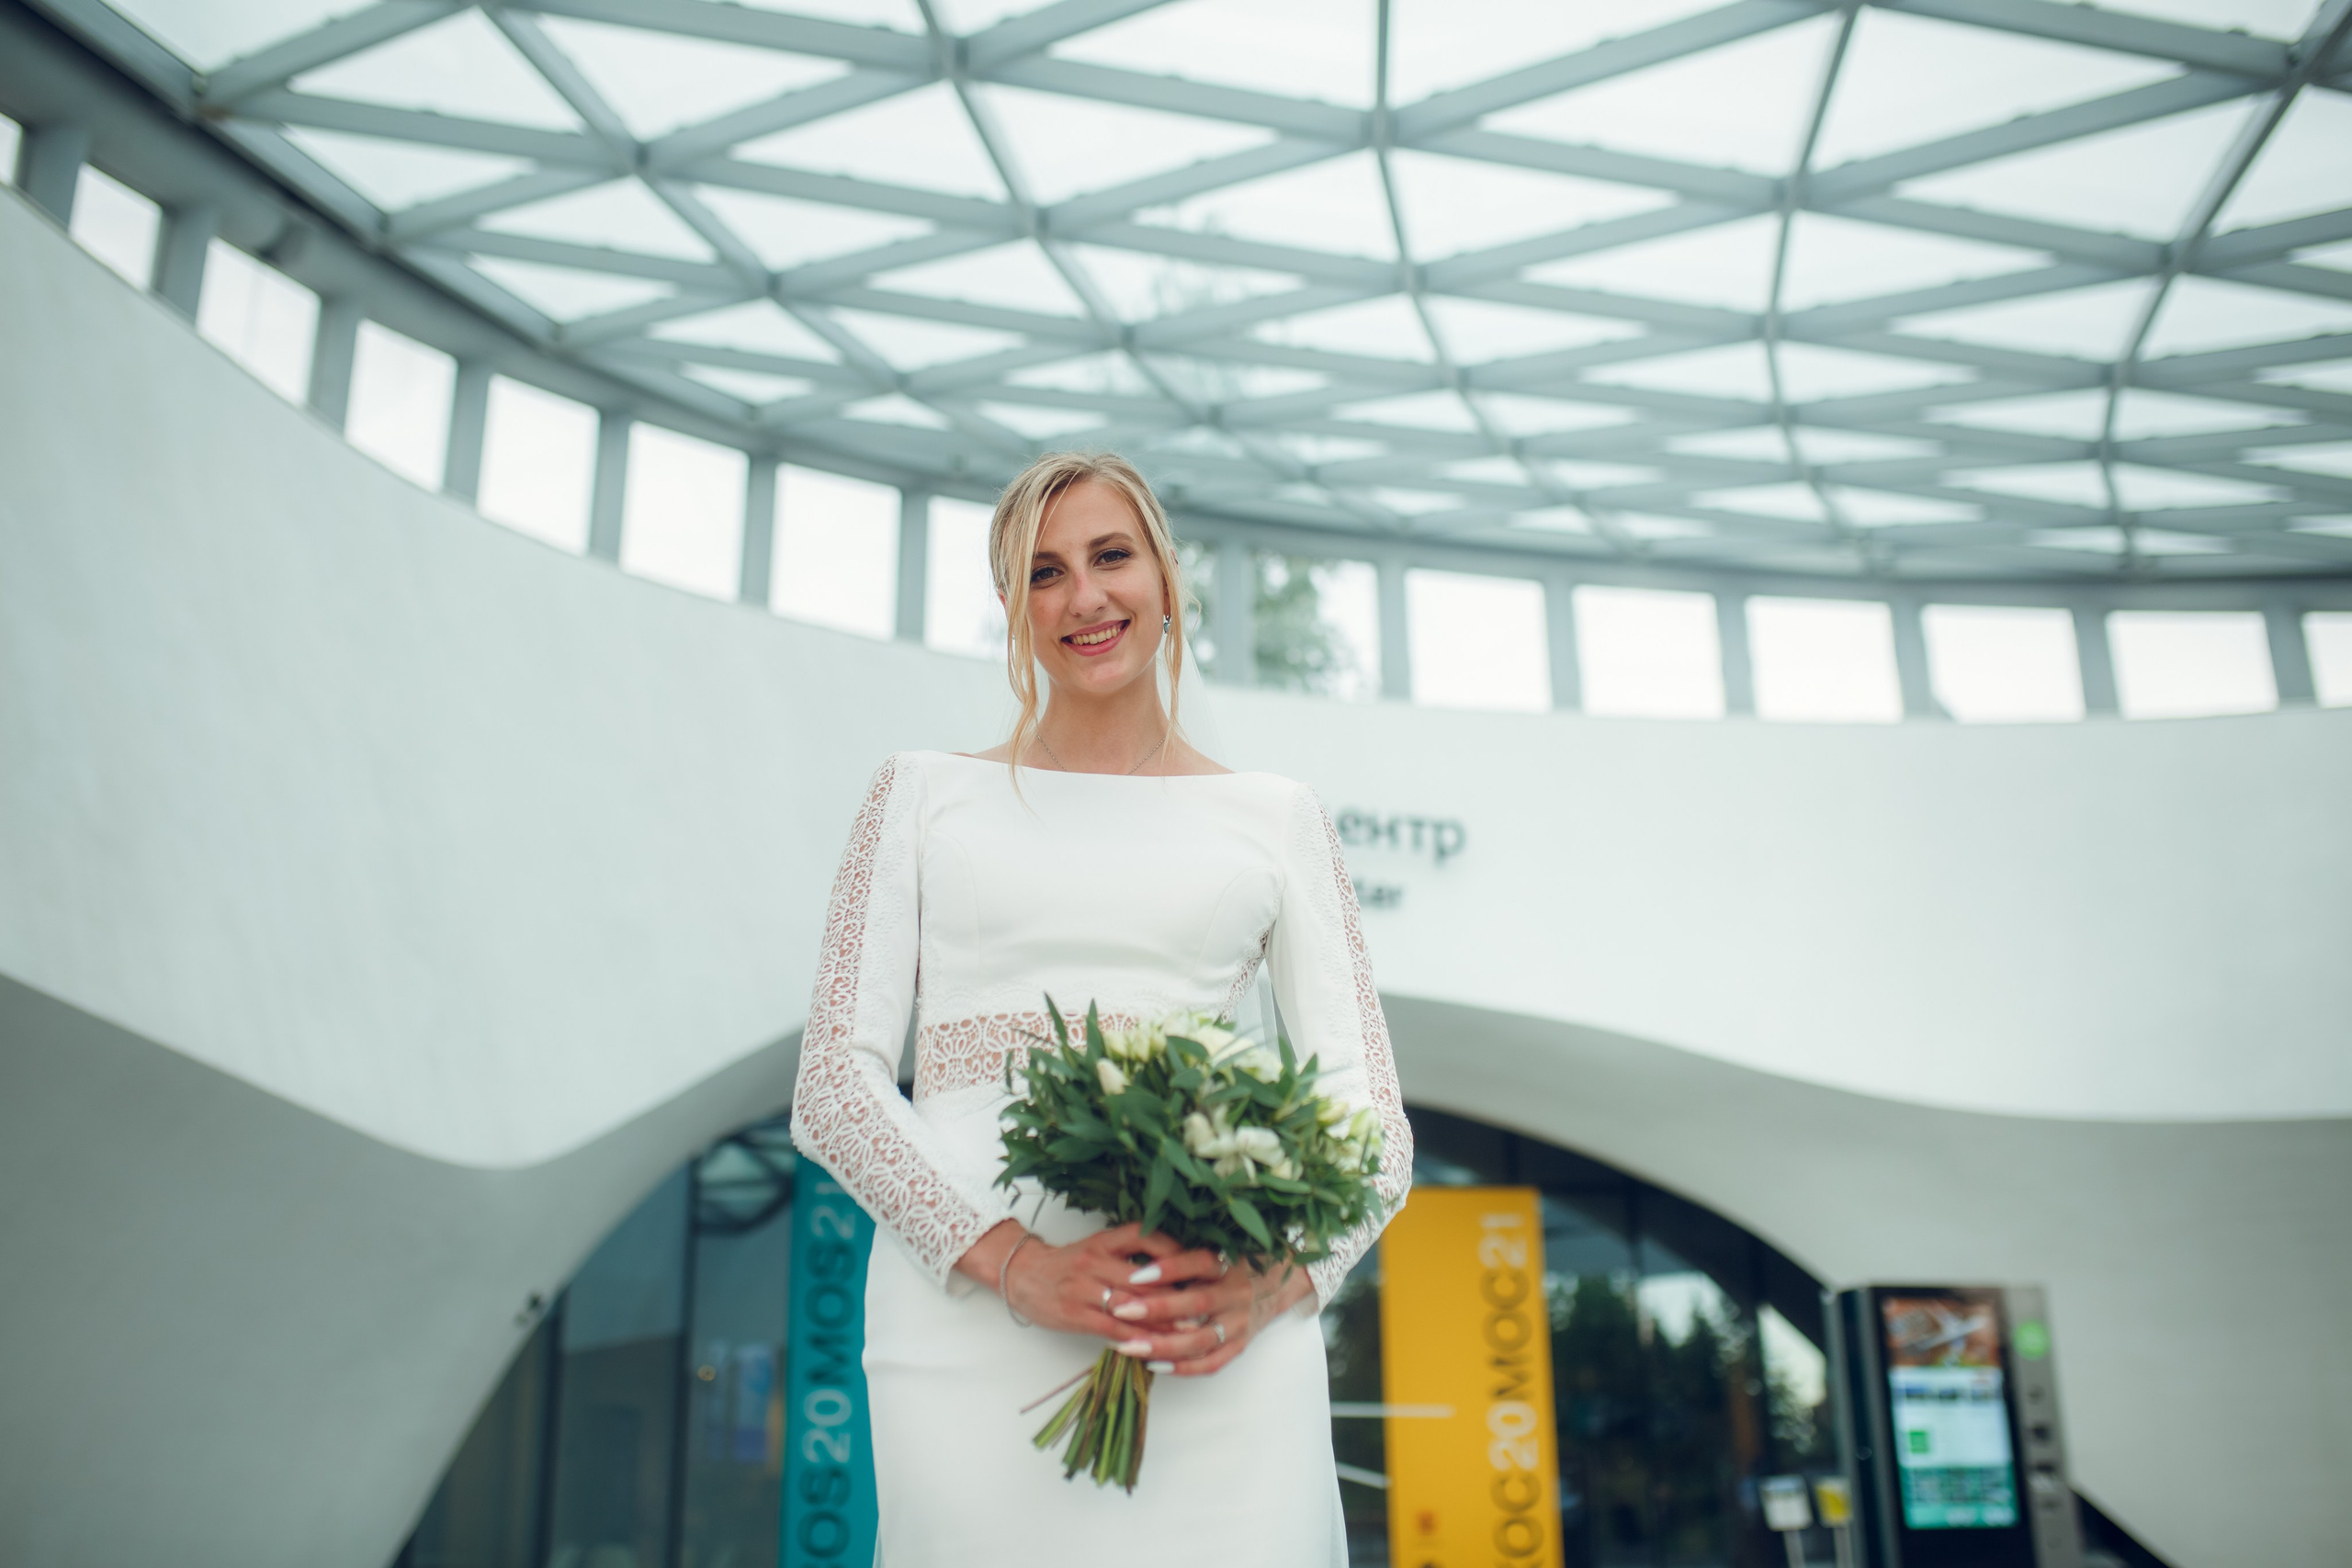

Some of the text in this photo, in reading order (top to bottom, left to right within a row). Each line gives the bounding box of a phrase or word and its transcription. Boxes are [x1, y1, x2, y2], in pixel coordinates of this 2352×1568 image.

[1337, 807, 1467, 868] ентр
[797, 1181, 856, 1568] OS20MOS21
[1478, 1213, 1545, 1568] ОС20МОС21
